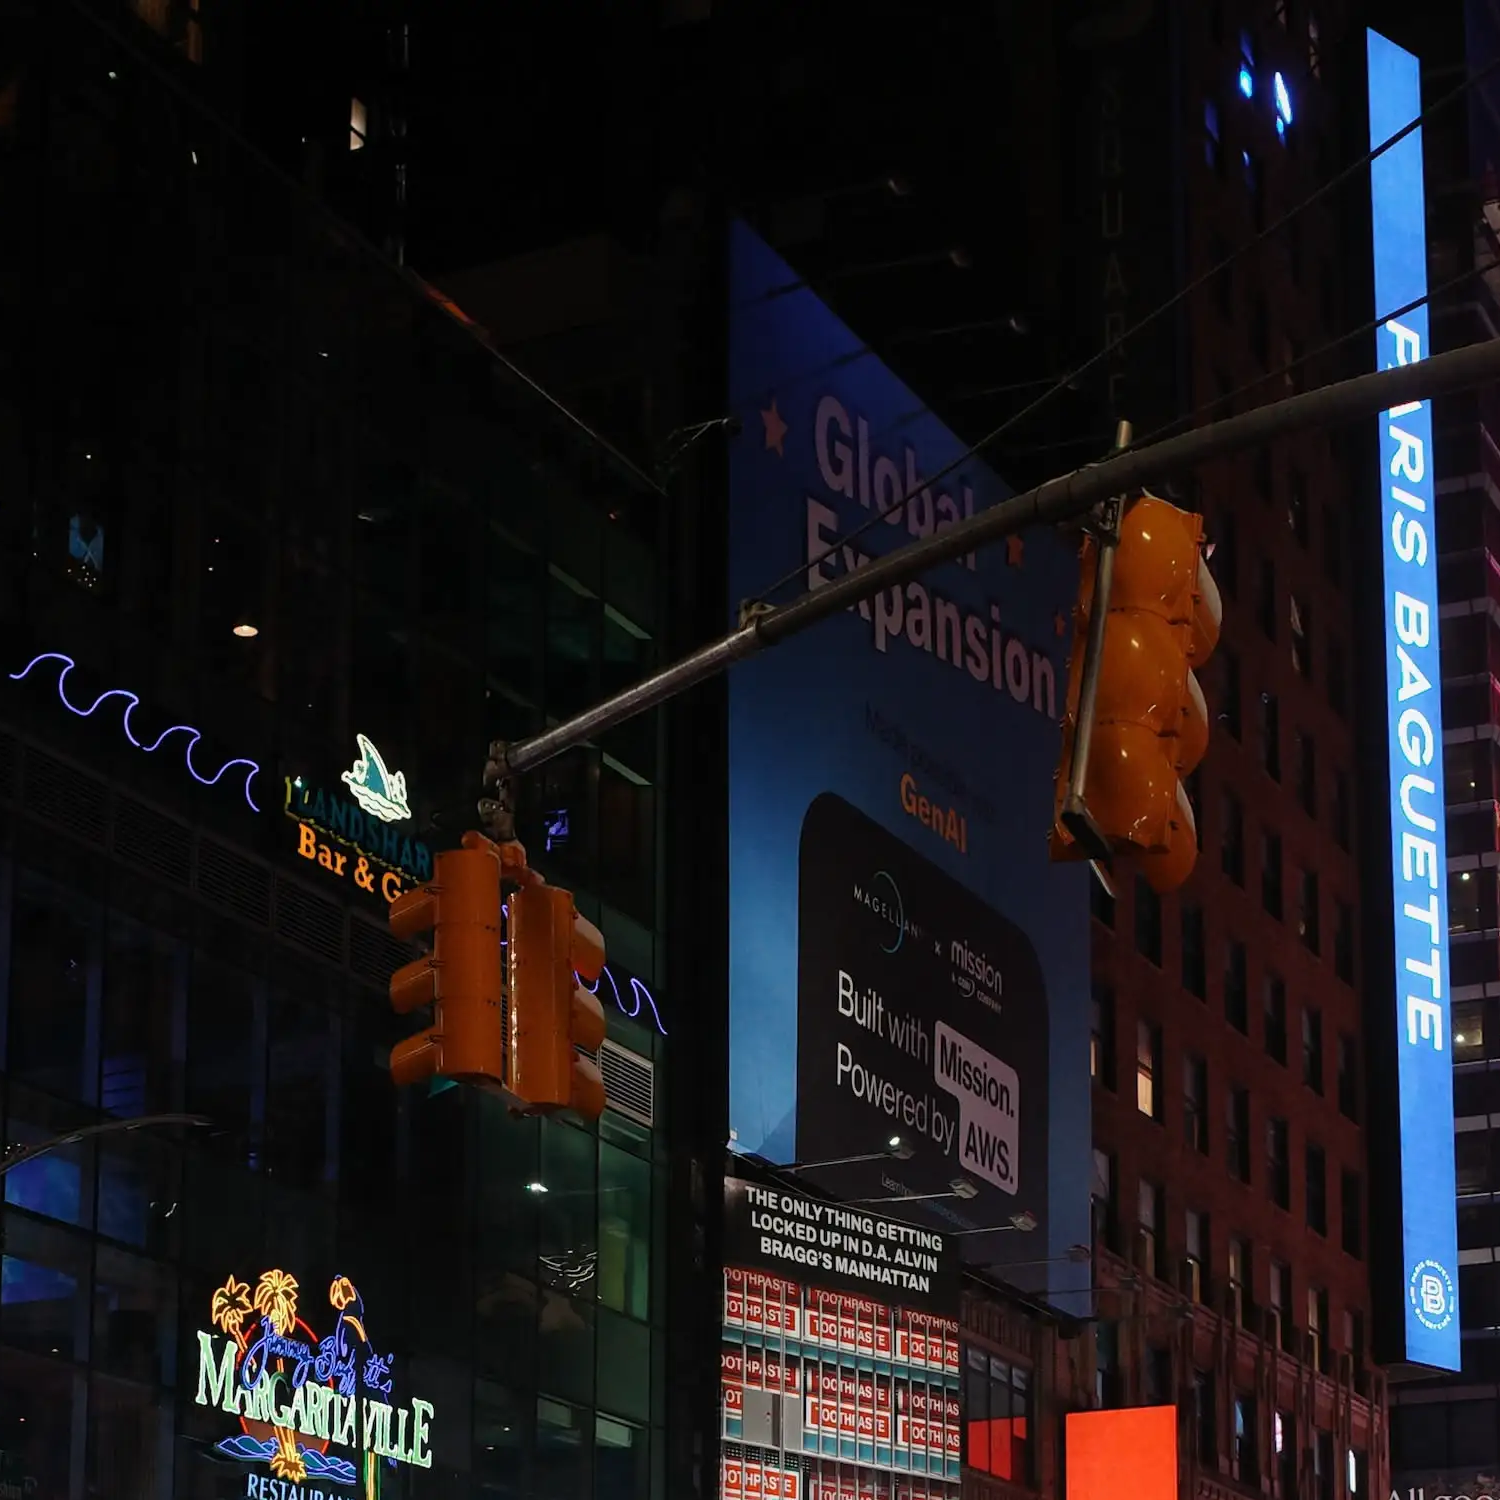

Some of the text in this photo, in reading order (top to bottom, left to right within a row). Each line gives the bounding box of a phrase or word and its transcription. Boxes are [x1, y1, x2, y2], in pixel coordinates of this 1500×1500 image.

[815, 396, 976, 572] Global
[900, 772, 968, 854] GenAI
[1395, 590, 1442, 1051] BAGUETTE
[297, 822, 348, 877] Bar
[354, 856, 375, 894] &
[853, 884, 919, 938] MAGELLAN
[951, 939, 1002, 995] mission
[836, 969, 930, 1066] Built with
[836, 1042, 955, 1156] Powered by
[939, 1032, 1015, 1119] Mission.
[964, 1122, 1015, 1184] AWS.
[745, 1185, 943, 1252] THE ONLY THING GETTING
[751, 1211, 938, 1273] LOCKED UP IN D.A. ALVIN
[760, 1236, 930, 1294] BRAGG'S MANHATTAN
